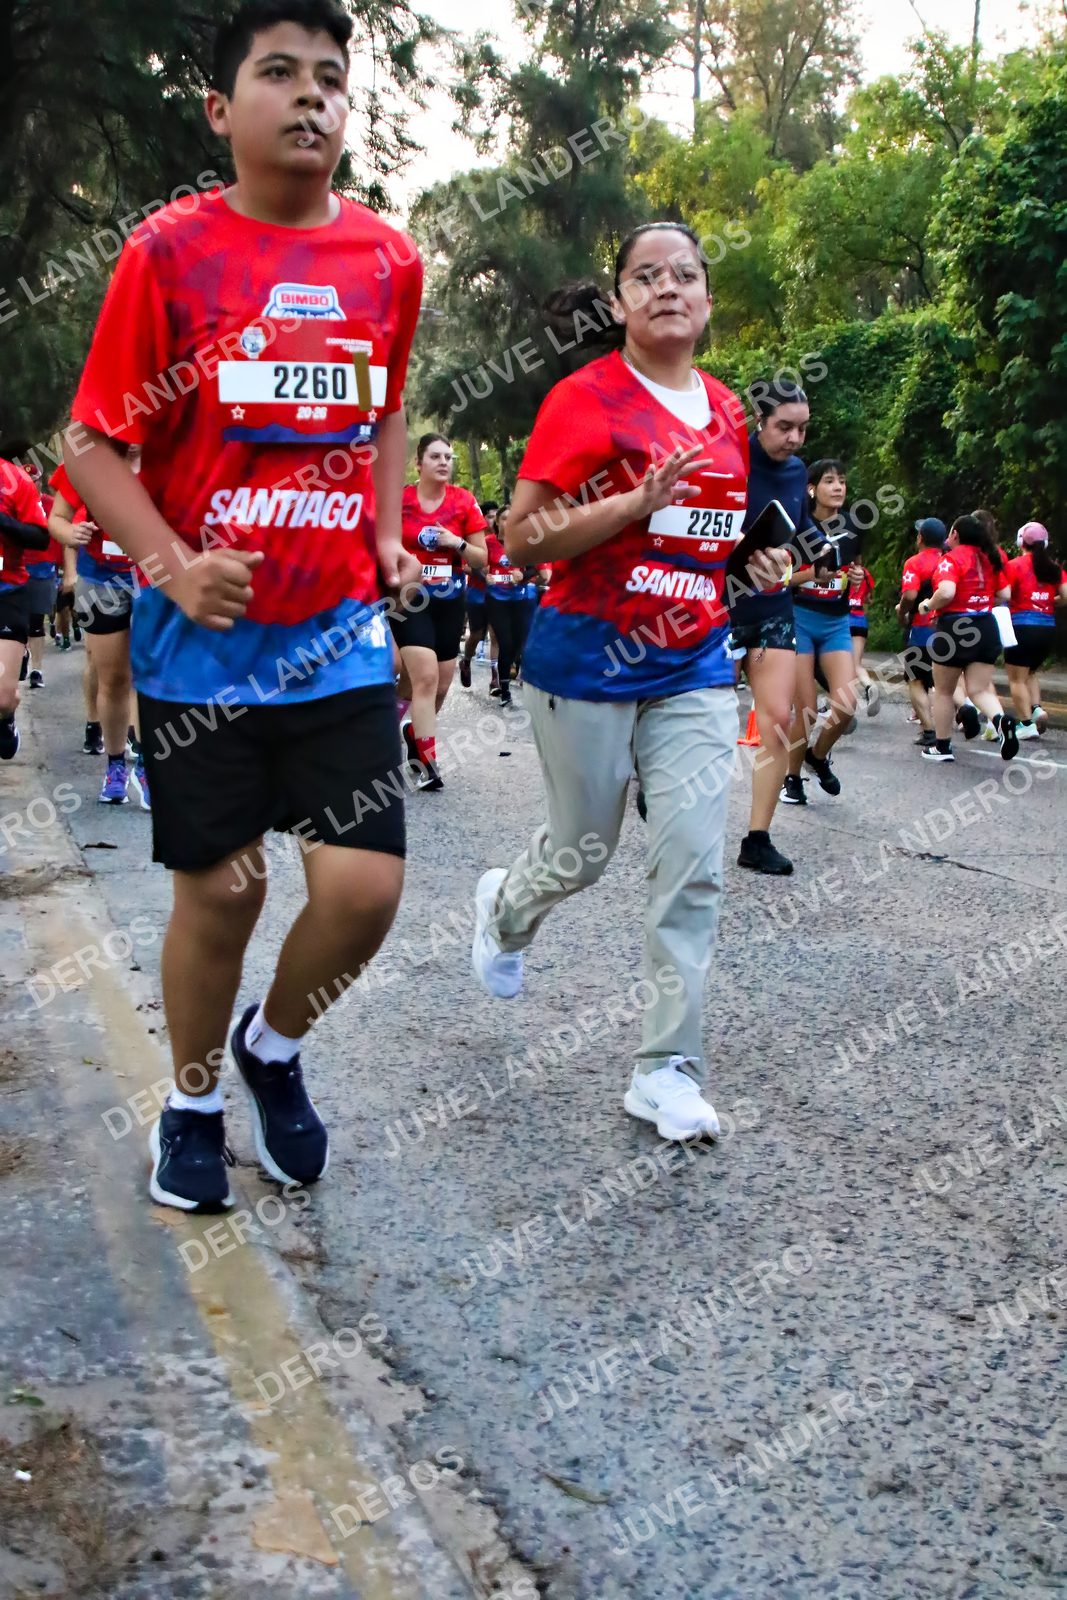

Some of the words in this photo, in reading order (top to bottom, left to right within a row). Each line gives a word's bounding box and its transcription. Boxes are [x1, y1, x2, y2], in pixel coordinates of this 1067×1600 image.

[281, 293, 329, 305] BIMBO
[274, 364, 347, 400] 2260
[204, 487, 364, 531] SANTIAGO
[687, 509, 734, 538] 2259
